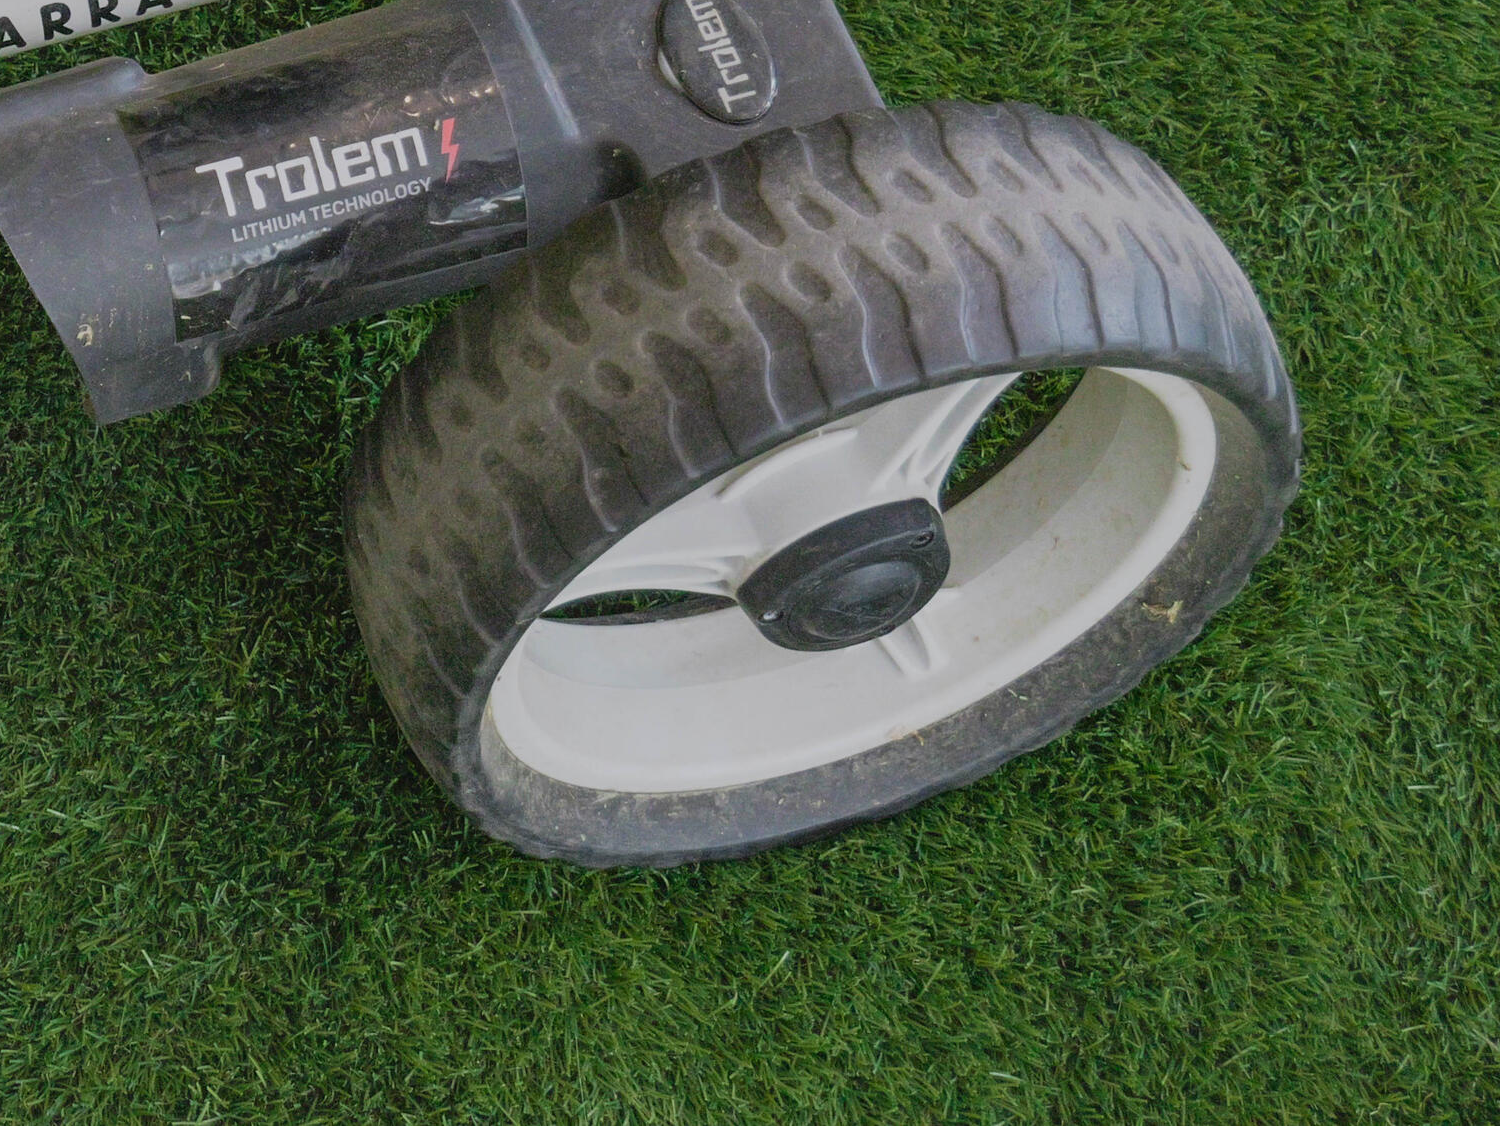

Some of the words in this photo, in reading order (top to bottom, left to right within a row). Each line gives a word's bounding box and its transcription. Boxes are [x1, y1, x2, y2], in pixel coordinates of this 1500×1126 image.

[195, 127, 428, 217] Trolem
[231, 211, 307, 243] LITHIUM
[309, 177, 432, 222] TECHNOLOGY
